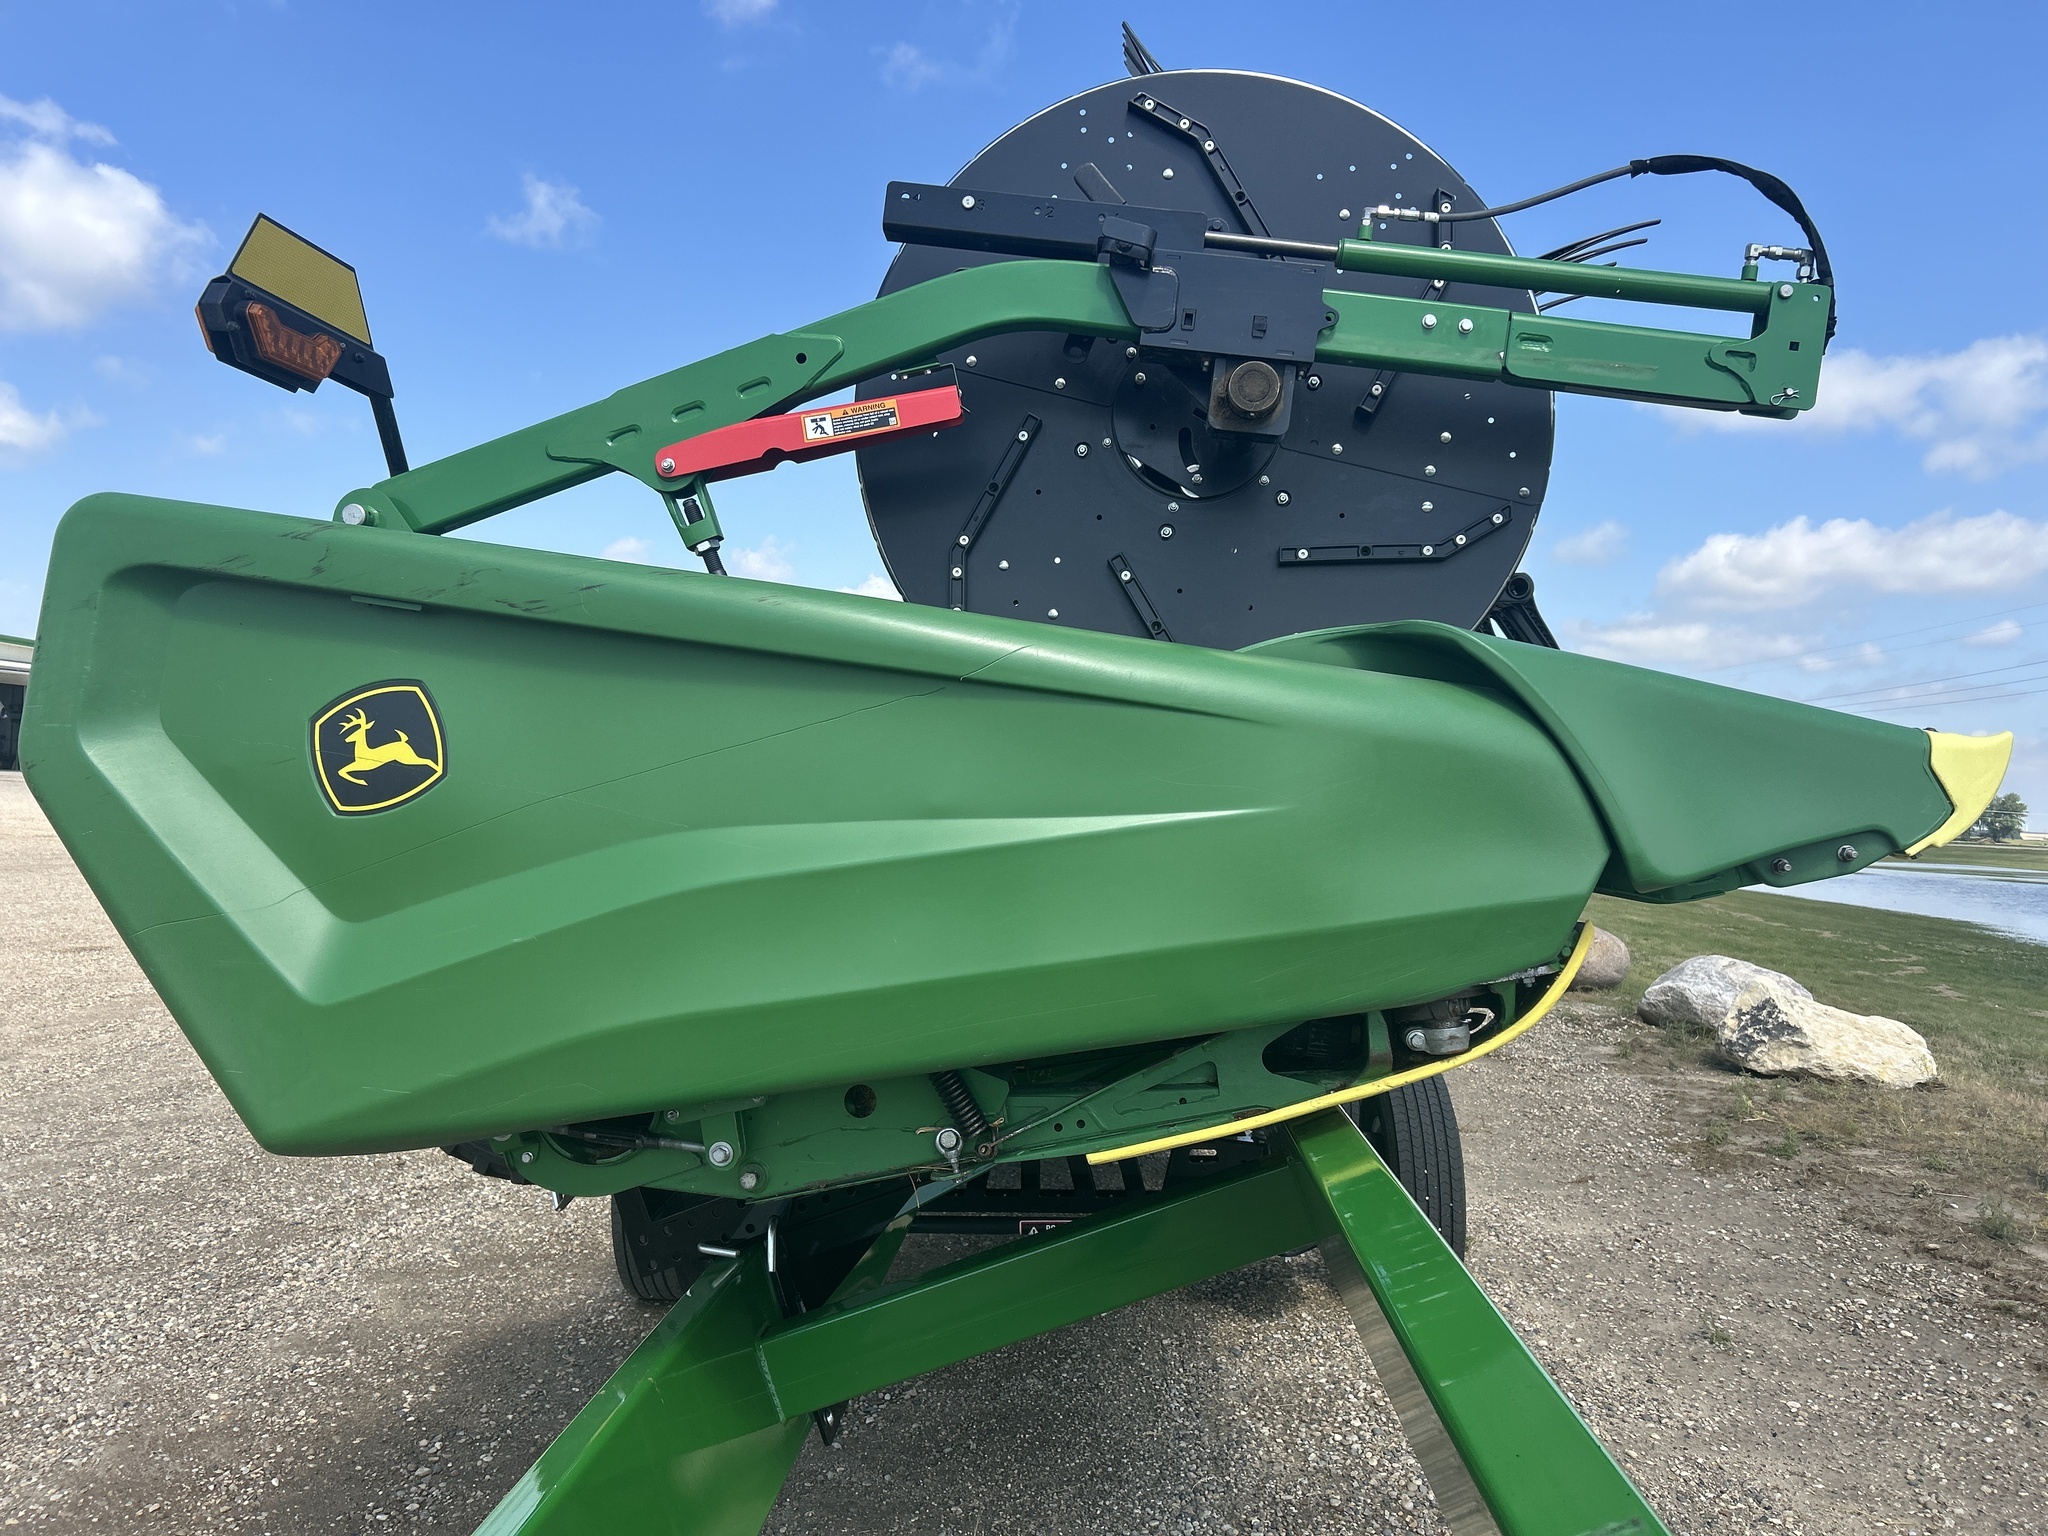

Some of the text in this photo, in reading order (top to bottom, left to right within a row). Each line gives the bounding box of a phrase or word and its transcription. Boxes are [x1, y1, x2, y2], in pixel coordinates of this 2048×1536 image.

[912, 193, 921, 203] 4
[976, 199, 986, 211] 3
[1045, 206, 1055, 218] 2
[850, 402, 886, 414] WARNING
